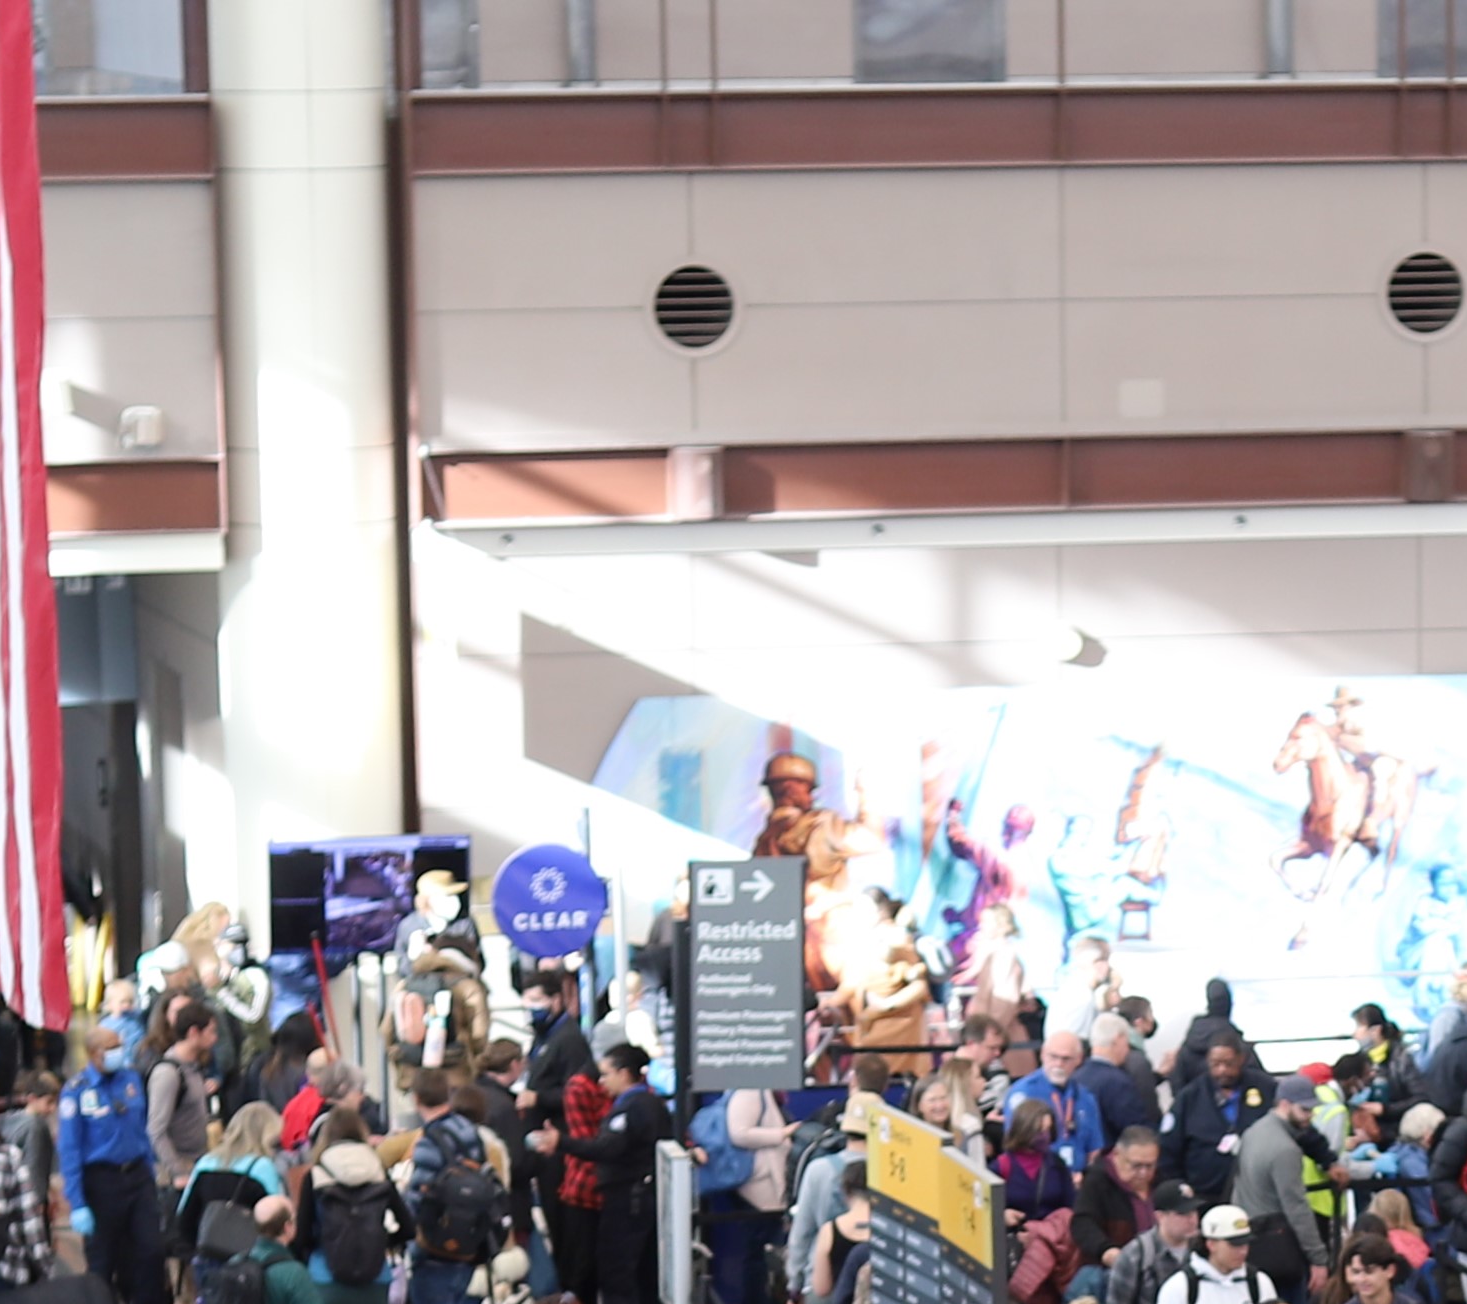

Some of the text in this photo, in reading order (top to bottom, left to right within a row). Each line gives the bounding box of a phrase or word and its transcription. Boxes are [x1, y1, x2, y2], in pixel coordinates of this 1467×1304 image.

[513, 911, 588, 931] CLEAR
[697, 919, 797, 941] Restricted
[697, 944, 763, 963] Access
